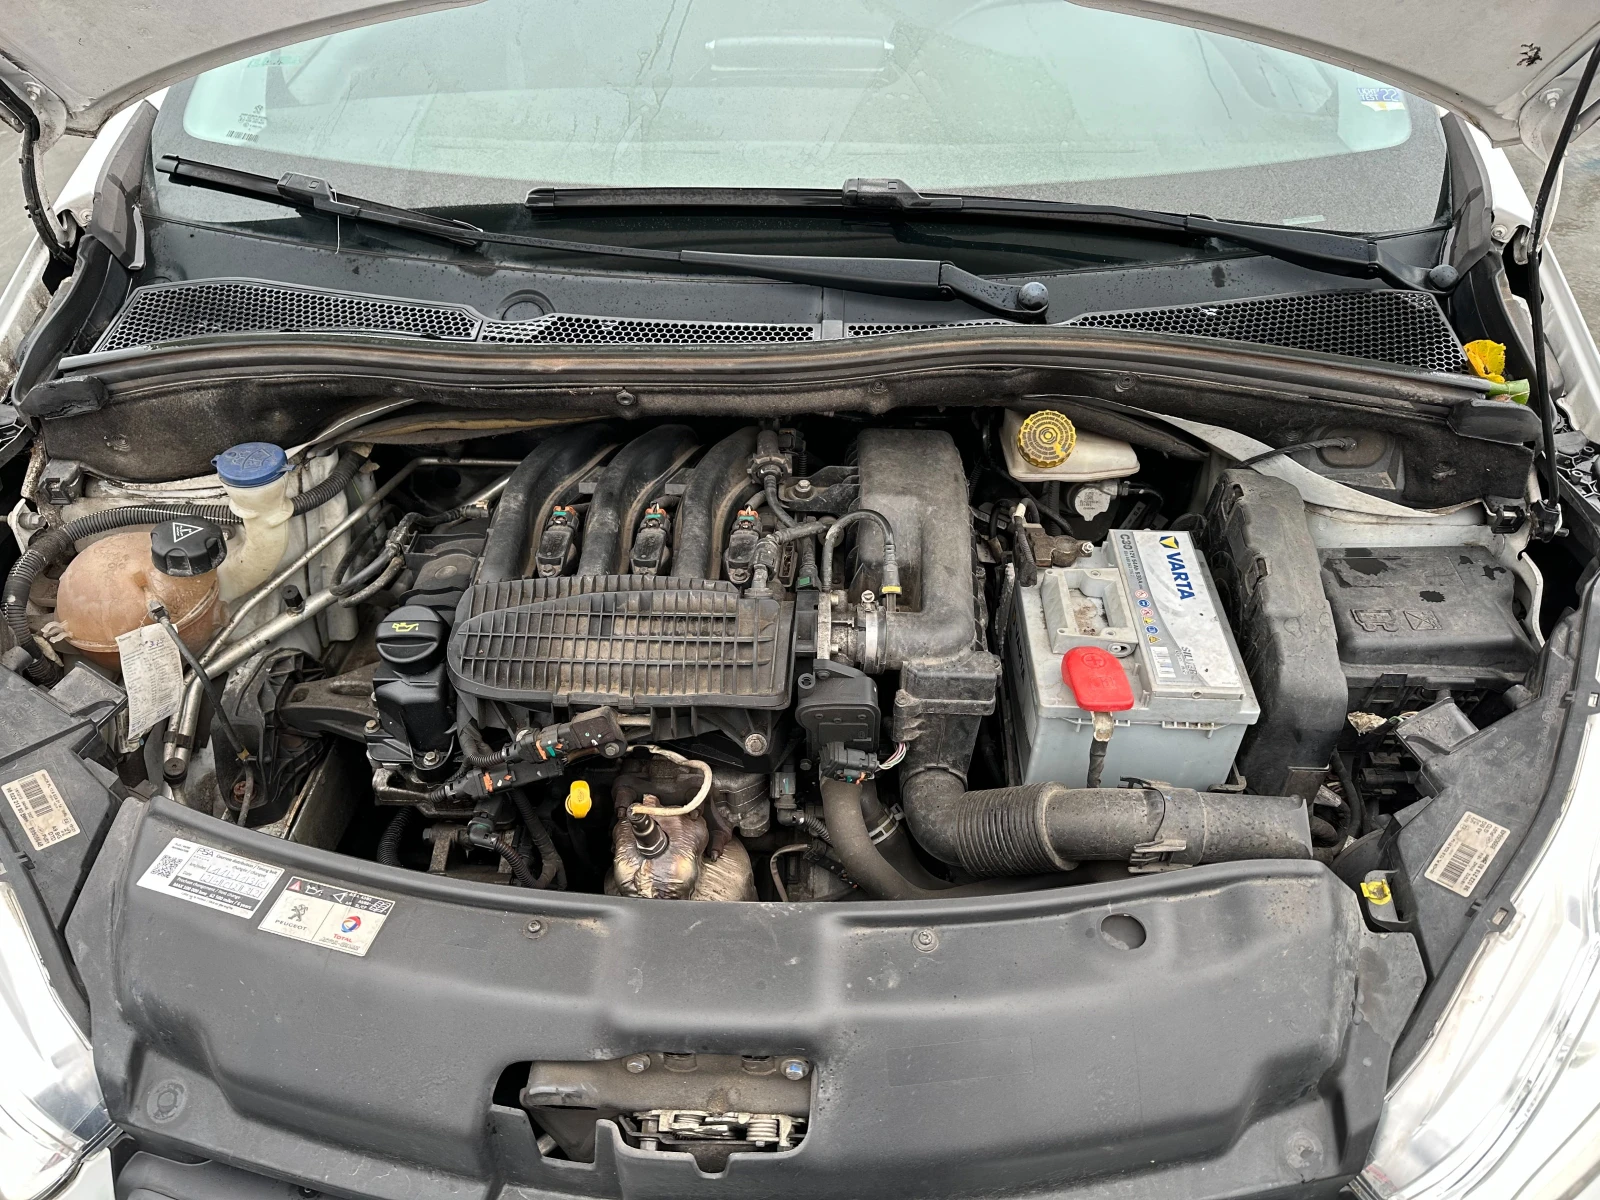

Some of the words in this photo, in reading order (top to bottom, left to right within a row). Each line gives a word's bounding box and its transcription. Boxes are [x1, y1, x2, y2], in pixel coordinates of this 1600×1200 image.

[1120, 534, 1132, 550] C30
[1167, 552, 1195, 600] VARTA
[196, 847, 215, 857] PSA
[275, 919, 307, 930] PEUGEOT
[334, 933, 352, 943] TOTAL
